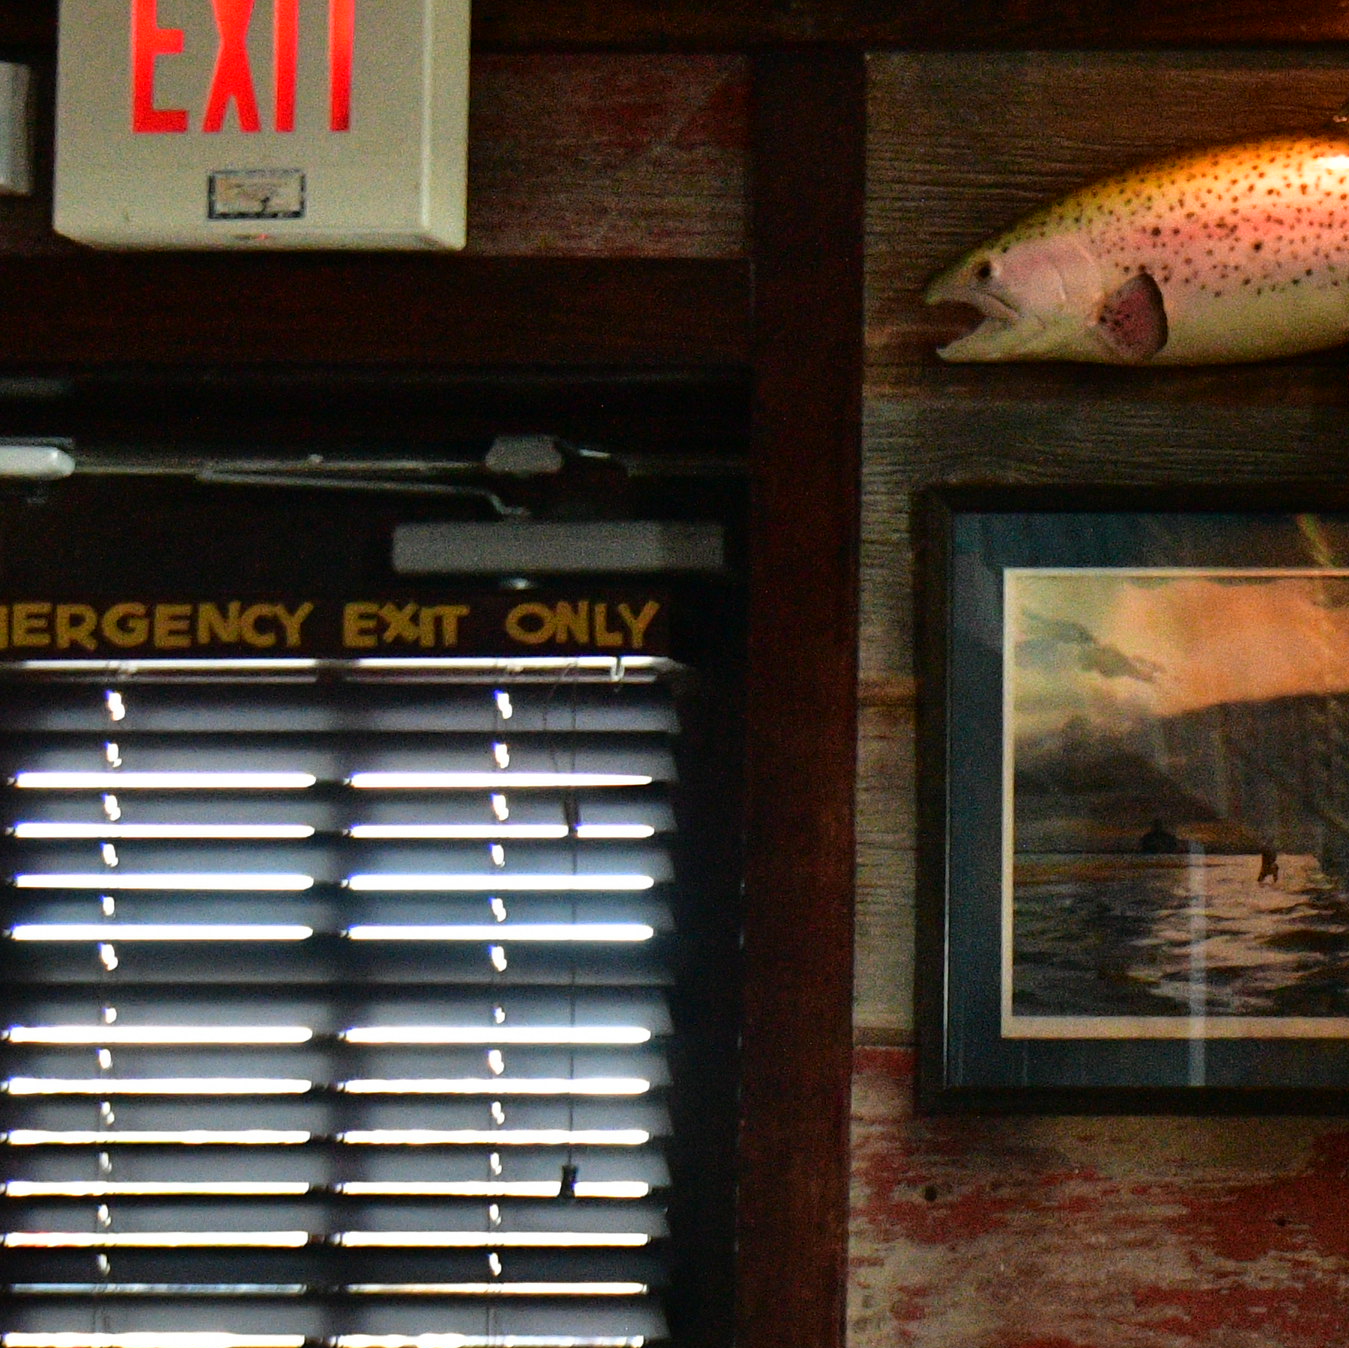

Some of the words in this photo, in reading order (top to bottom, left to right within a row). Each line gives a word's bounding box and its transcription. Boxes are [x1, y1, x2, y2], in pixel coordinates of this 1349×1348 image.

[0, 602, 314, 650] ERGENCY
[343, 602, 470, 648] EXIT
[505, 601, 659, 649] ONLY
